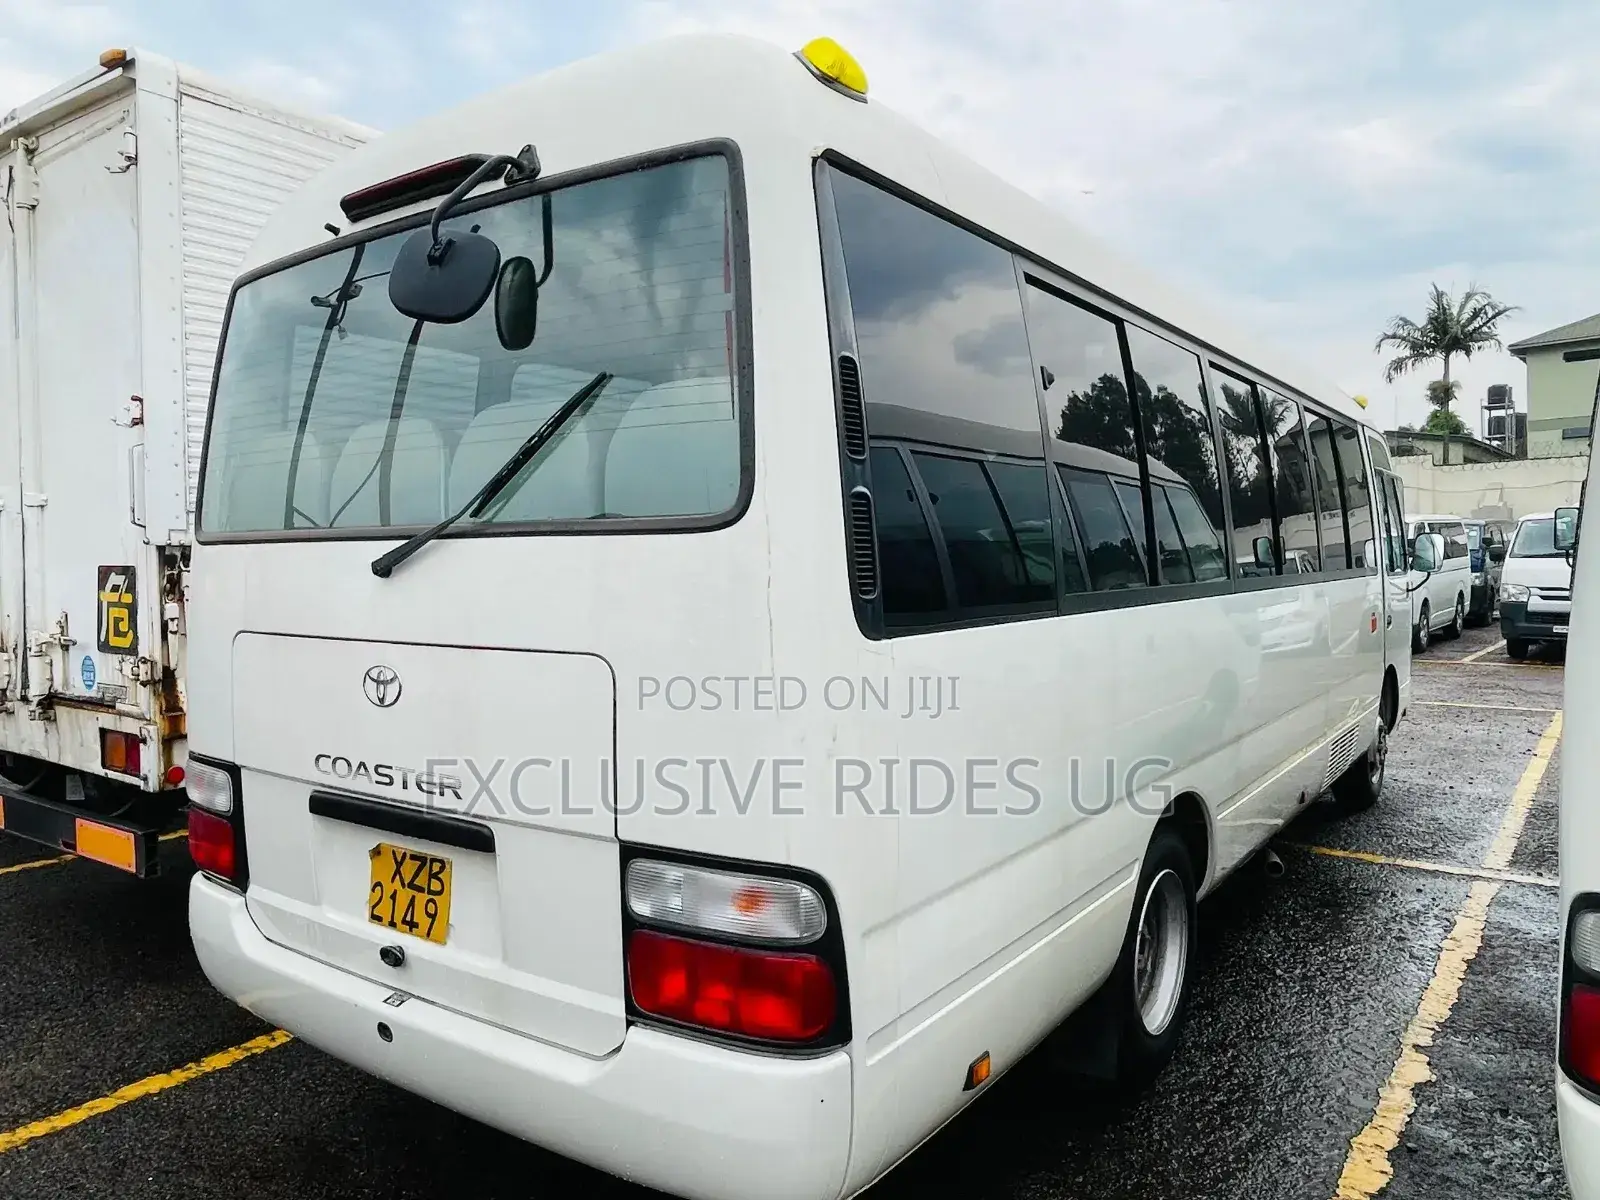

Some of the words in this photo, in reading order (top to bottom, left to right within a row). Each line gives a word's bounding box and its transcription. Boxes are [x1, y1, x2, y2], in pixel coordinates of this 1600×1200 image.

[100, 572, 133, 648] 危
[314, 753, 463, 801] COASTER
[391, 849, 446, 896] XZB
[370, 881, 438, 939] 2149
